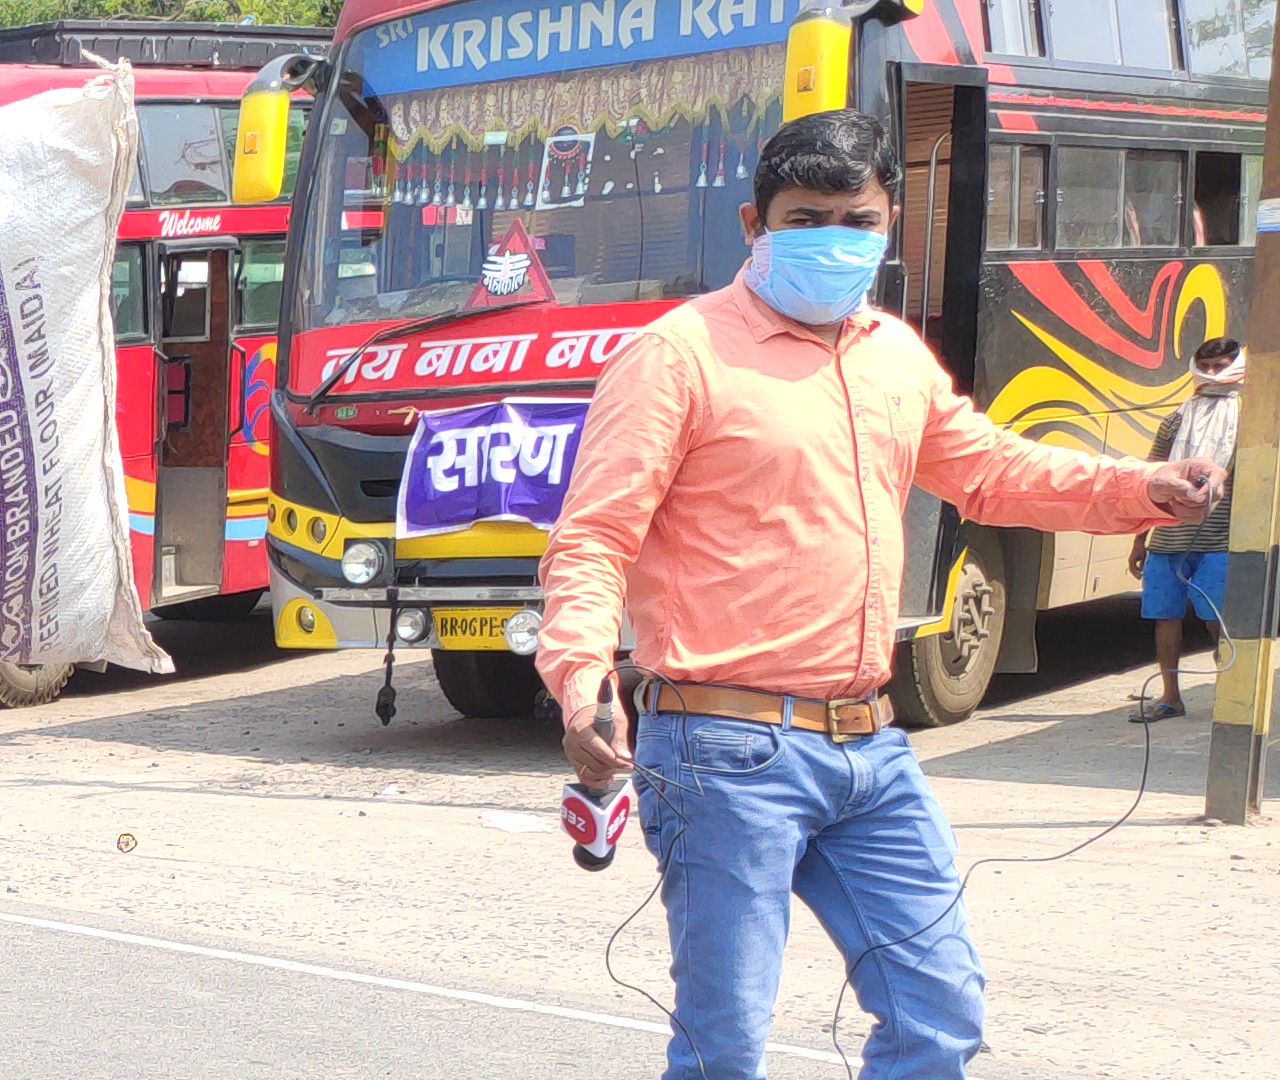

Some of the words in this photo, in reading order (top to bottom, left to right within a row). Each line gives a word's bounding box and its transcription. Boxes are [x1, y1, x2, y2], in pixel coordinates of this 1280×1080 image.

[375, 17, 415, 49] SRI
[415, 0, 657, 73] KRISHNA
[158, 209, 221, 237] Welcome
[414, 333, 539, 377] बाबा
[34, 378, 61, 476] FLOUR
[42, 476, 63, 562] WHEAT
[3, 541, 29, 599] NON
